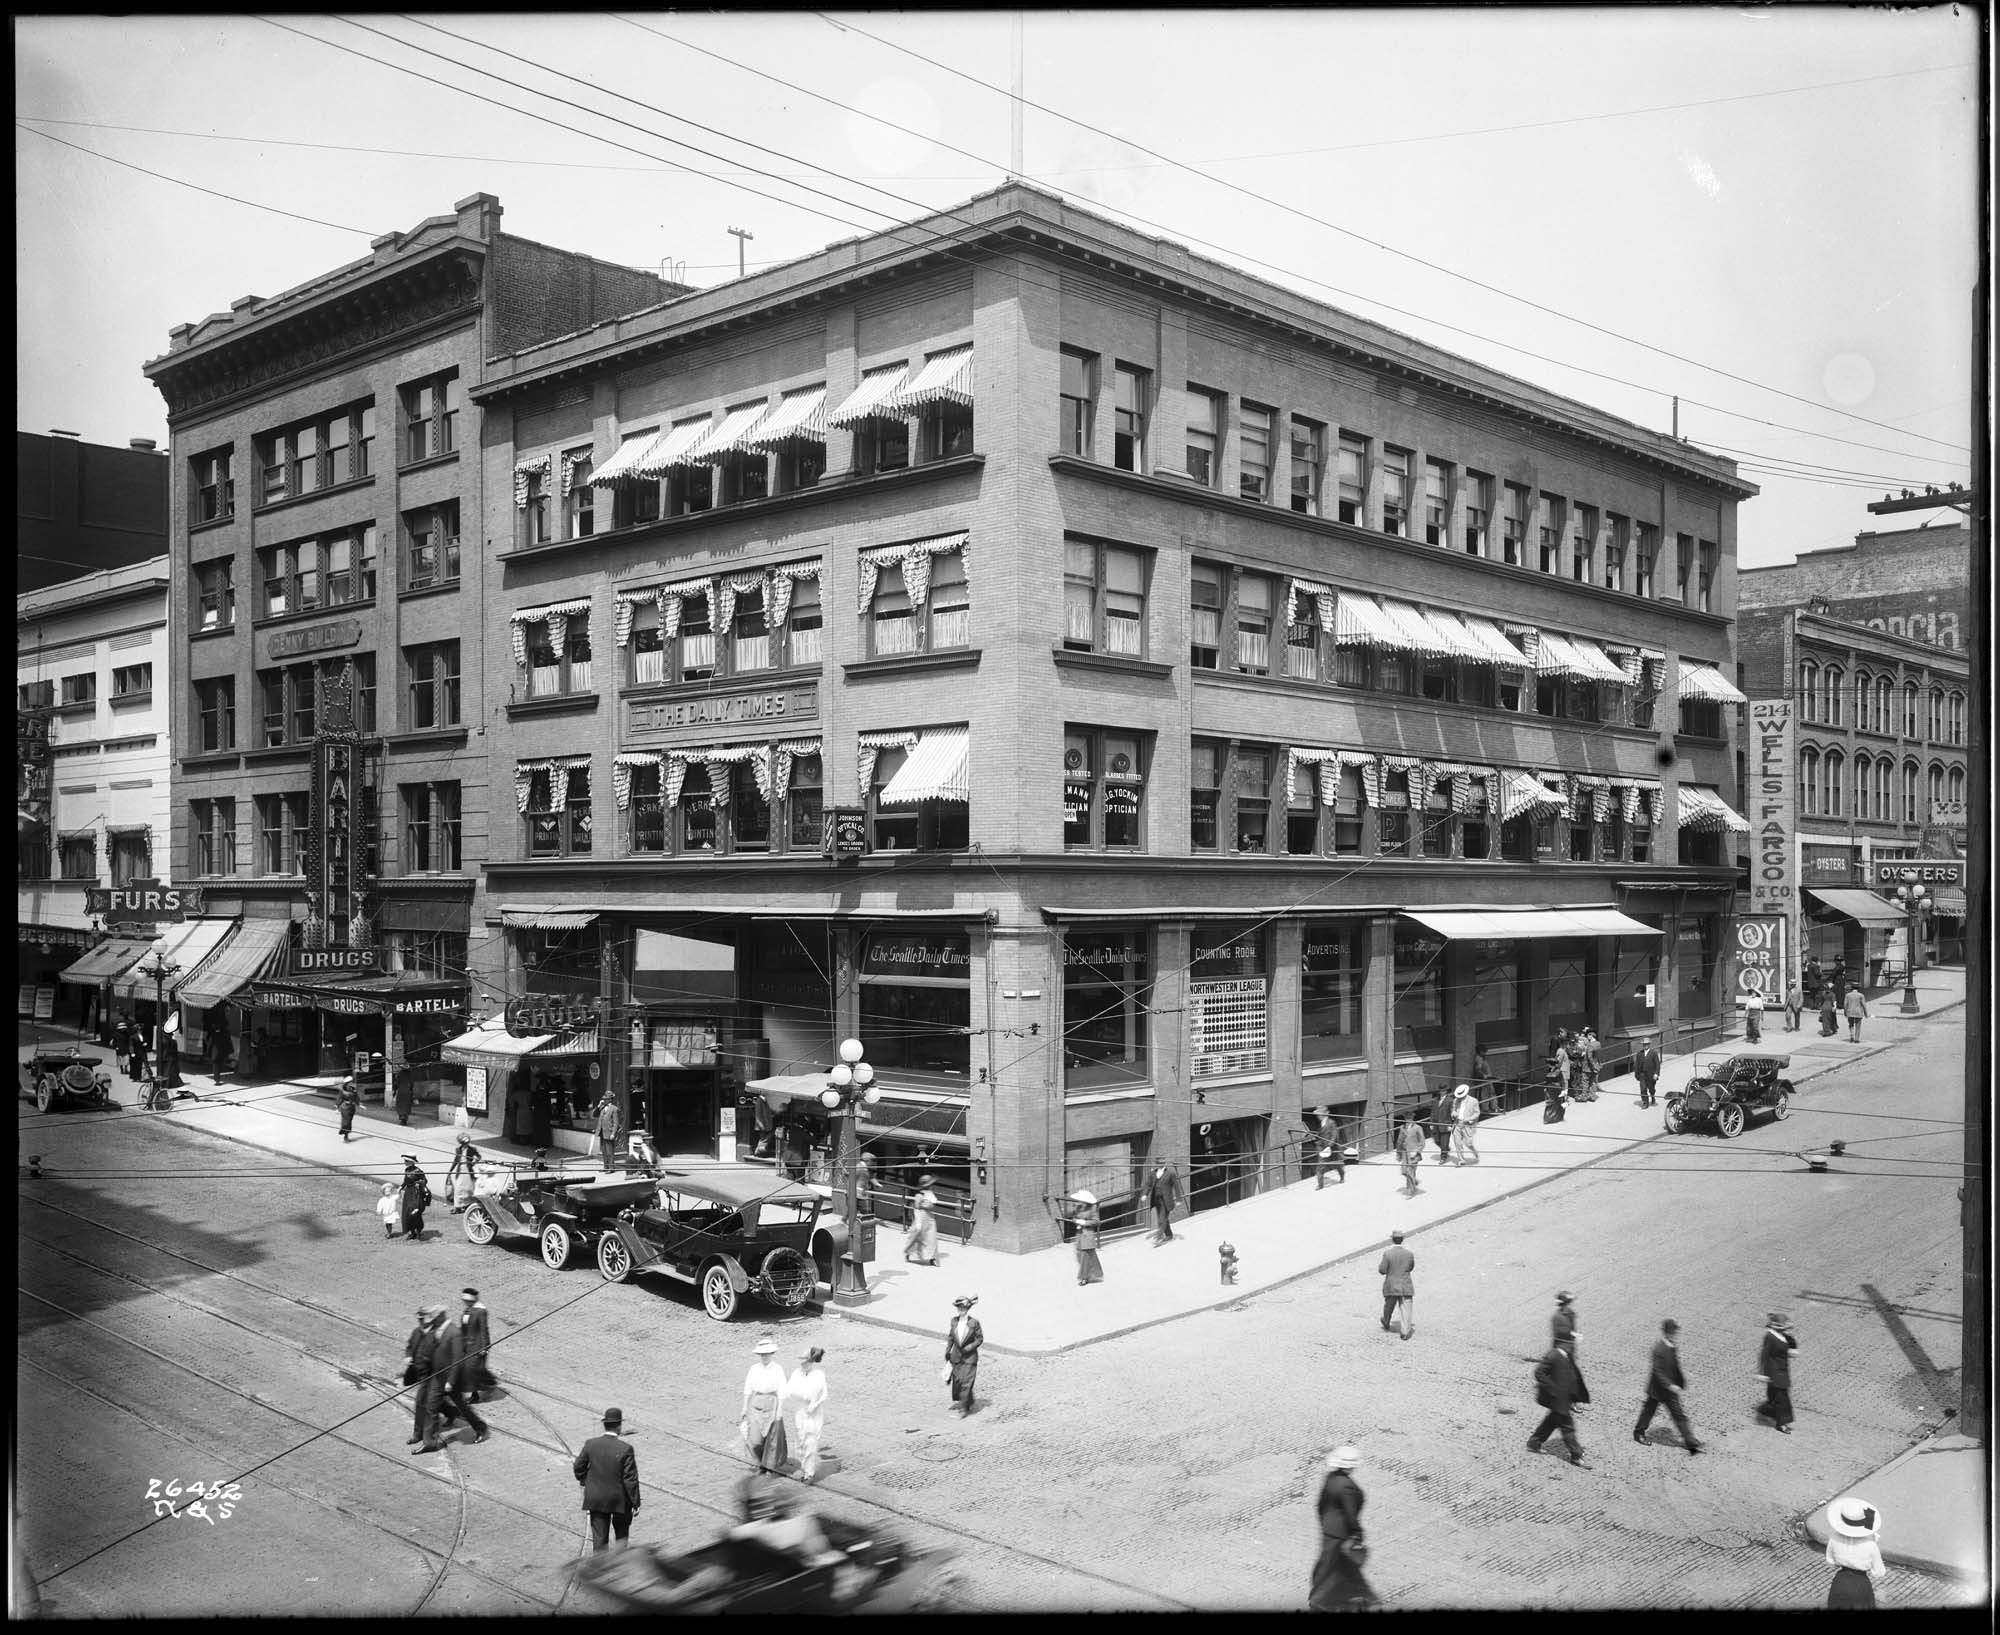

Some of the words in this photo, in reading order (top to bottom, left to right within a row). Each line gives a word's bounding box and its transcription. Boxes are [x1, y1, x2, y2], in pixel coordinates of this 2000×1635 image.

[655, 707, 684, 727] THE
[689, 700, 730, 723] DAILY
[738, 695, 785, 718] TIMES
[1754, 703, 1791, 718] 214
[1757, 719, 1788, 793] WELLS
[1064, 802, 1088, 812] TICIAN
[1105, 804, 1137, 814] OPTICIAN
[838, 822, 857, 832] OPTICAL
[329, 747, 348, 943] BARTELL
[1760, 805, 1786, 880] FARGO
[1816, 857, 1846, 871] OYSTERS
[1880, 866, 1958, 881] OYSTERS
[110, 891, 181, 910] FURS
[1736, 922, 1776, 949] OY
[301, 952, 374, 968] DRUGS
[871, 945, 888, 962] The
[889, 945, 918, 963] Seattle
[917, 946, 941, 968] Daily
[942, 947, 970, 964] Times
[1064, 949, 1078, 965] The
[1078, 948, 1105, 964] Seattle
[1106, 947, 1124, 966] Daily
[1124, 946, 1147, 963] Times
[1195, 947, 1231, 960] COUNTING
[1190, 981, 1238, 994] NORTHWESTERN
[1240, 980, 1263, 992] LEAGUE
[264, 993, 301, 1007] BARTELL
[334, 999, 365, 1013] DRUGS
[396, 998, 460, 1013] BARTELL
